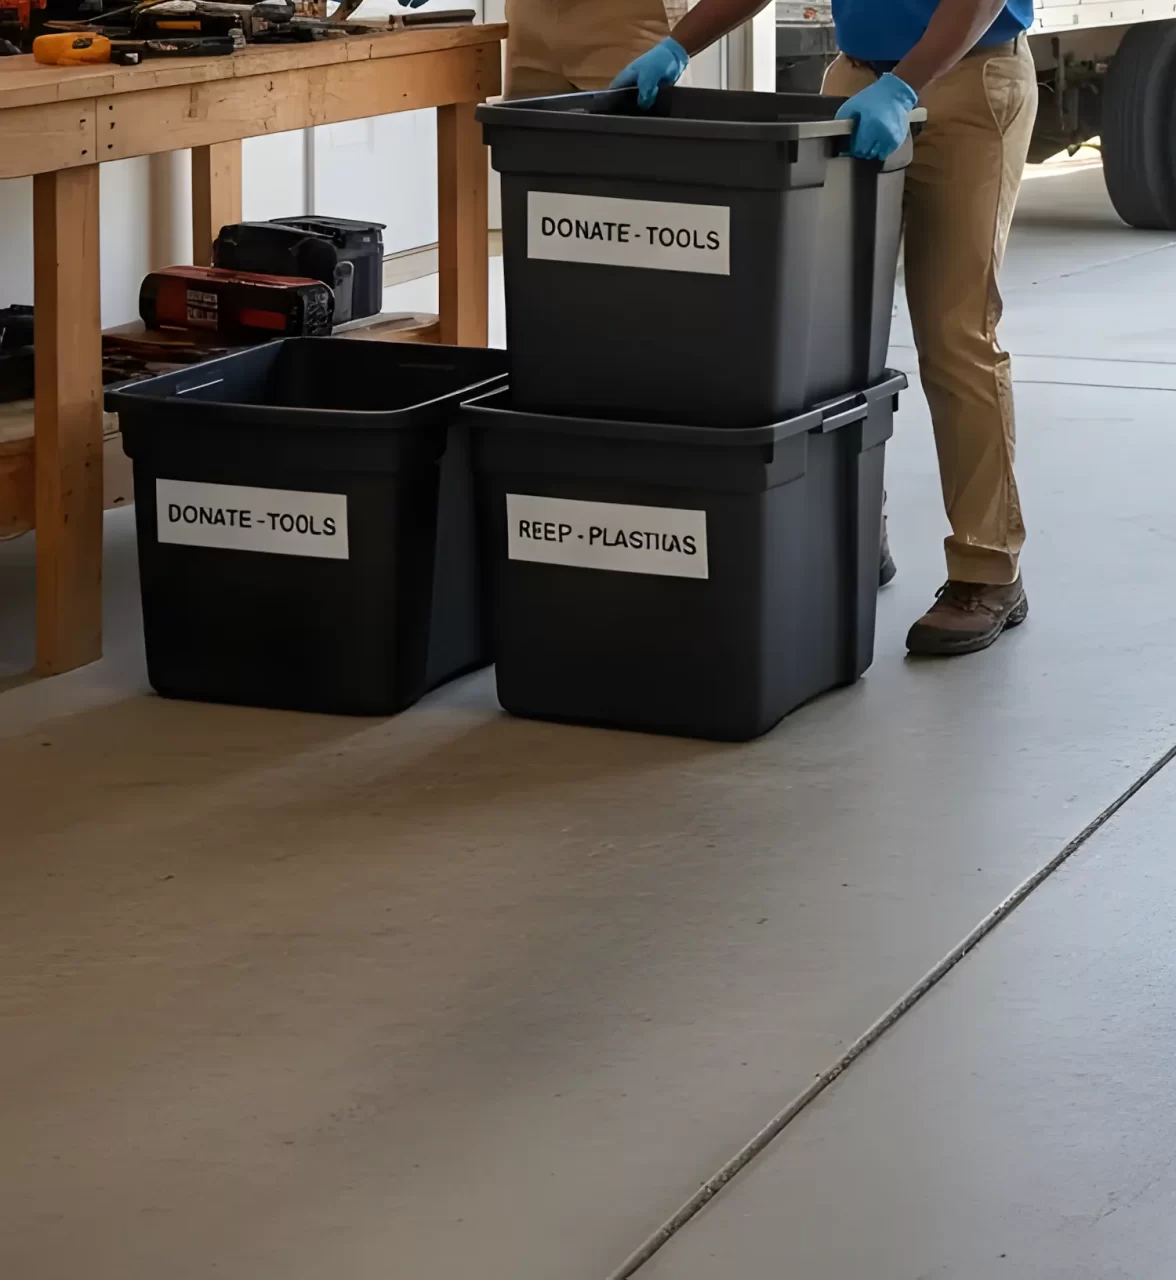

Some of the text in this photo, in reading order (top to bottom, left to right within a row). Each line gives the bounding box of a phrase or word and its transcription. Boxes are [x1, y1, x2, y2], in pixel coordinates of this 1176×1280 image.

[541, 216, 631, 243] DONATE
[645, 226, 720, 251] TOOLS
[167, 503, 253, 529] DONATE
